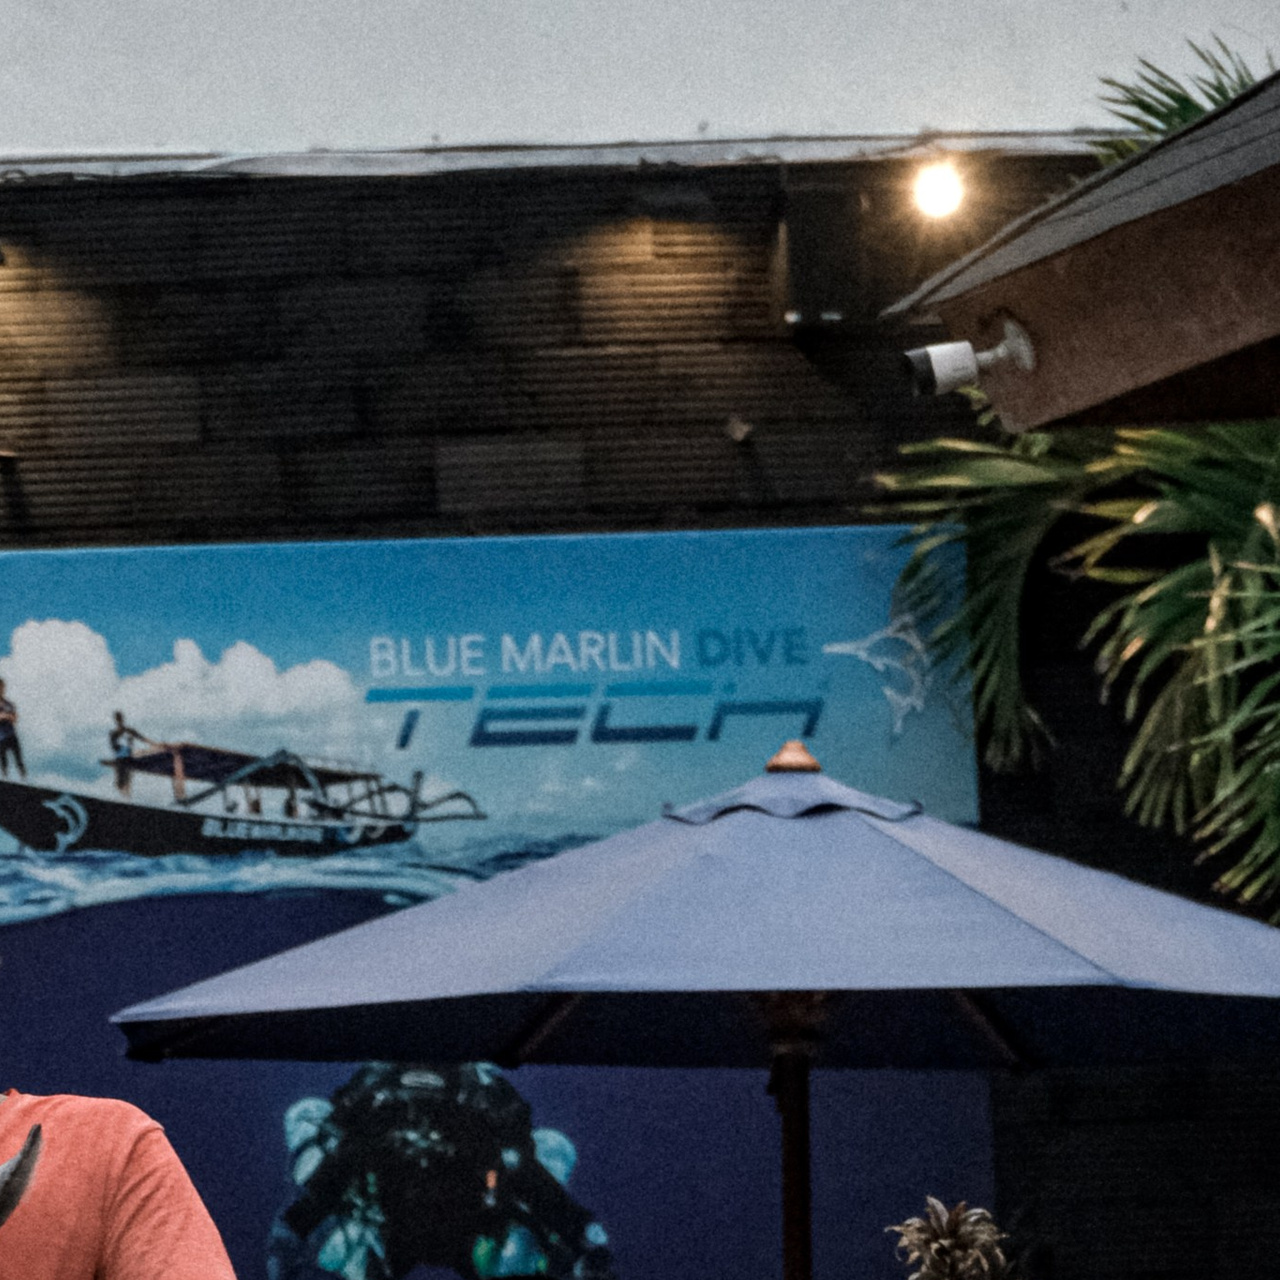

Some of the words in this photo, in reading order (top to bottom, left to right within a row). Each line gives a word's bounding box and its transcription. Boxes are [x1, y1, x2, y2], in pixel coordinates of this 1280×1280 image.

[369, 634, 486, 679] BLUE
[501, 629, 680, 674] MARLIN
[696, 626, 809, 668] DIVE
[365, 678, 824, 751] TECH
